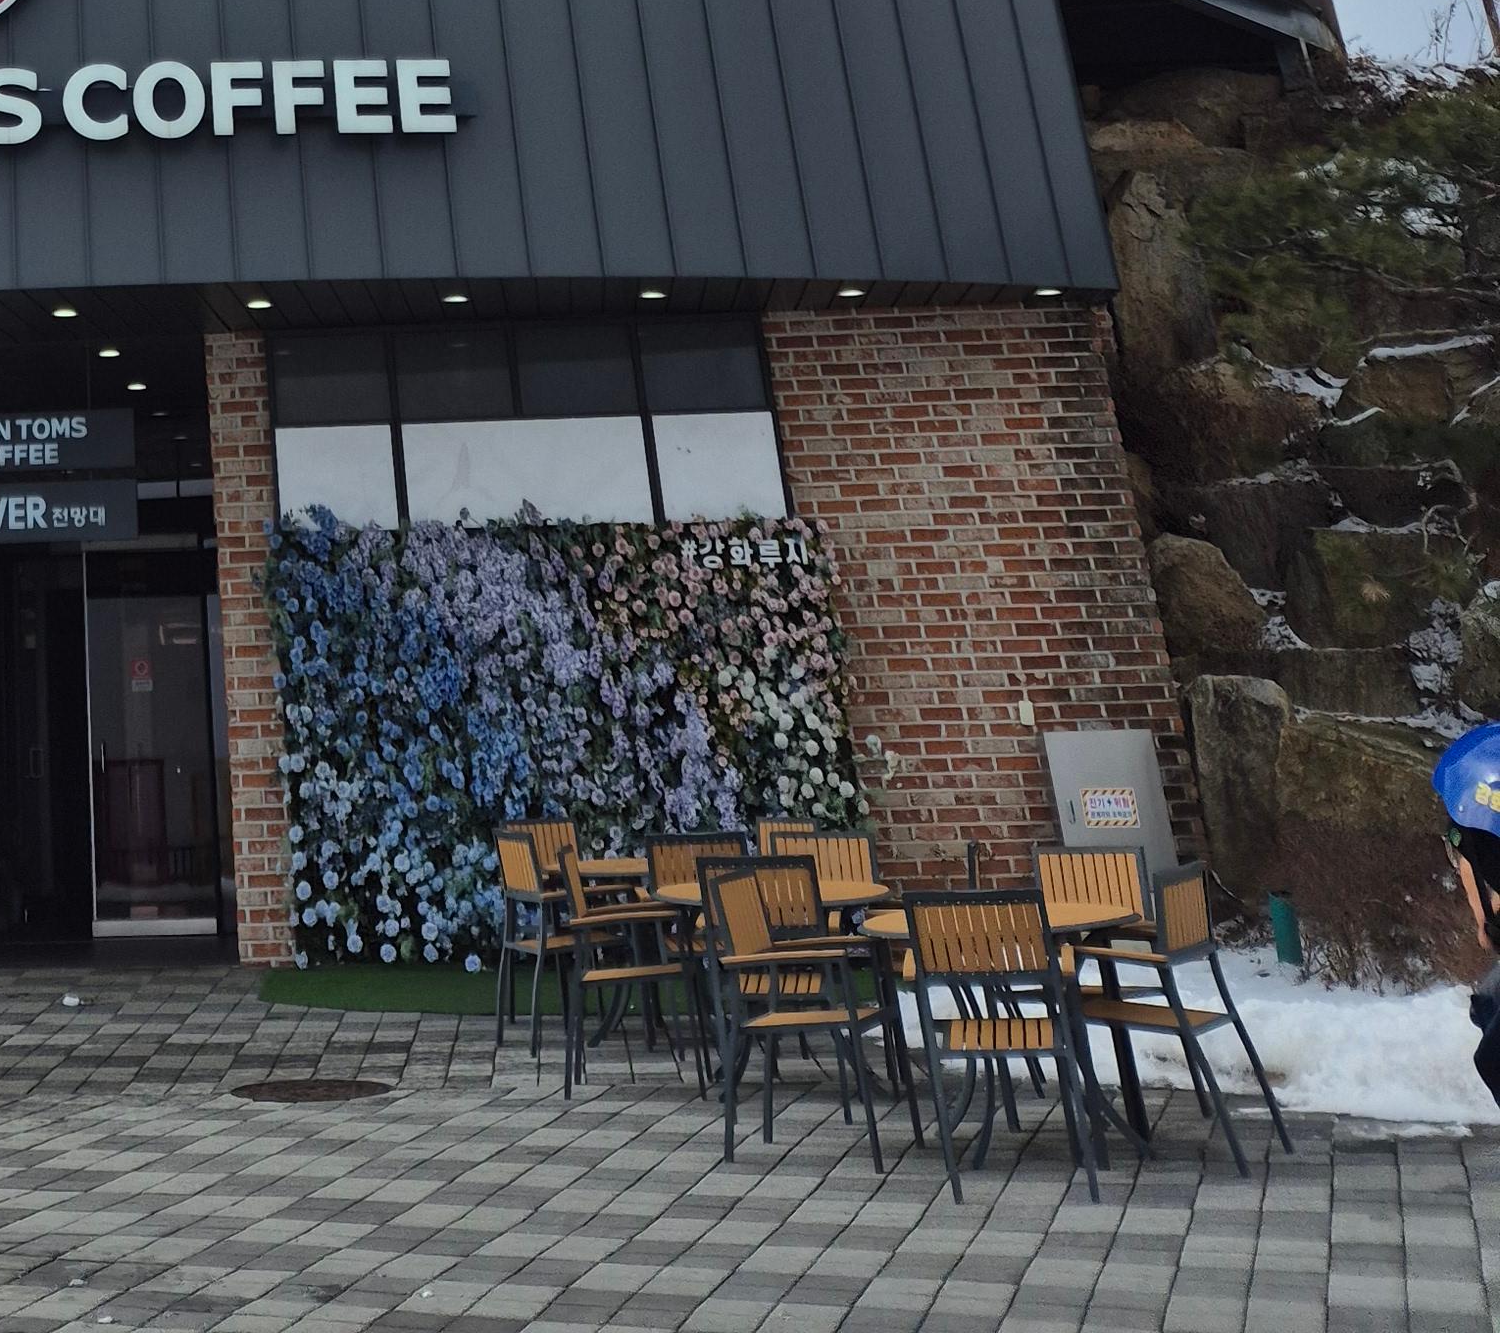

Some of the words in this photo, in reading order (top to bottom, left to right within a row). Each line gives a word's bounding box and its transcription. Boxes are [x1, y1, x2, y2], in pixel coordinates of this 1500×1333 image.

[62, 59, 458, 141] COFFEE
[15, 416, 88, 441] TOMS
[52, 506, 106, 528] 전망대
[680, 536, 810, 570] #강화루지
